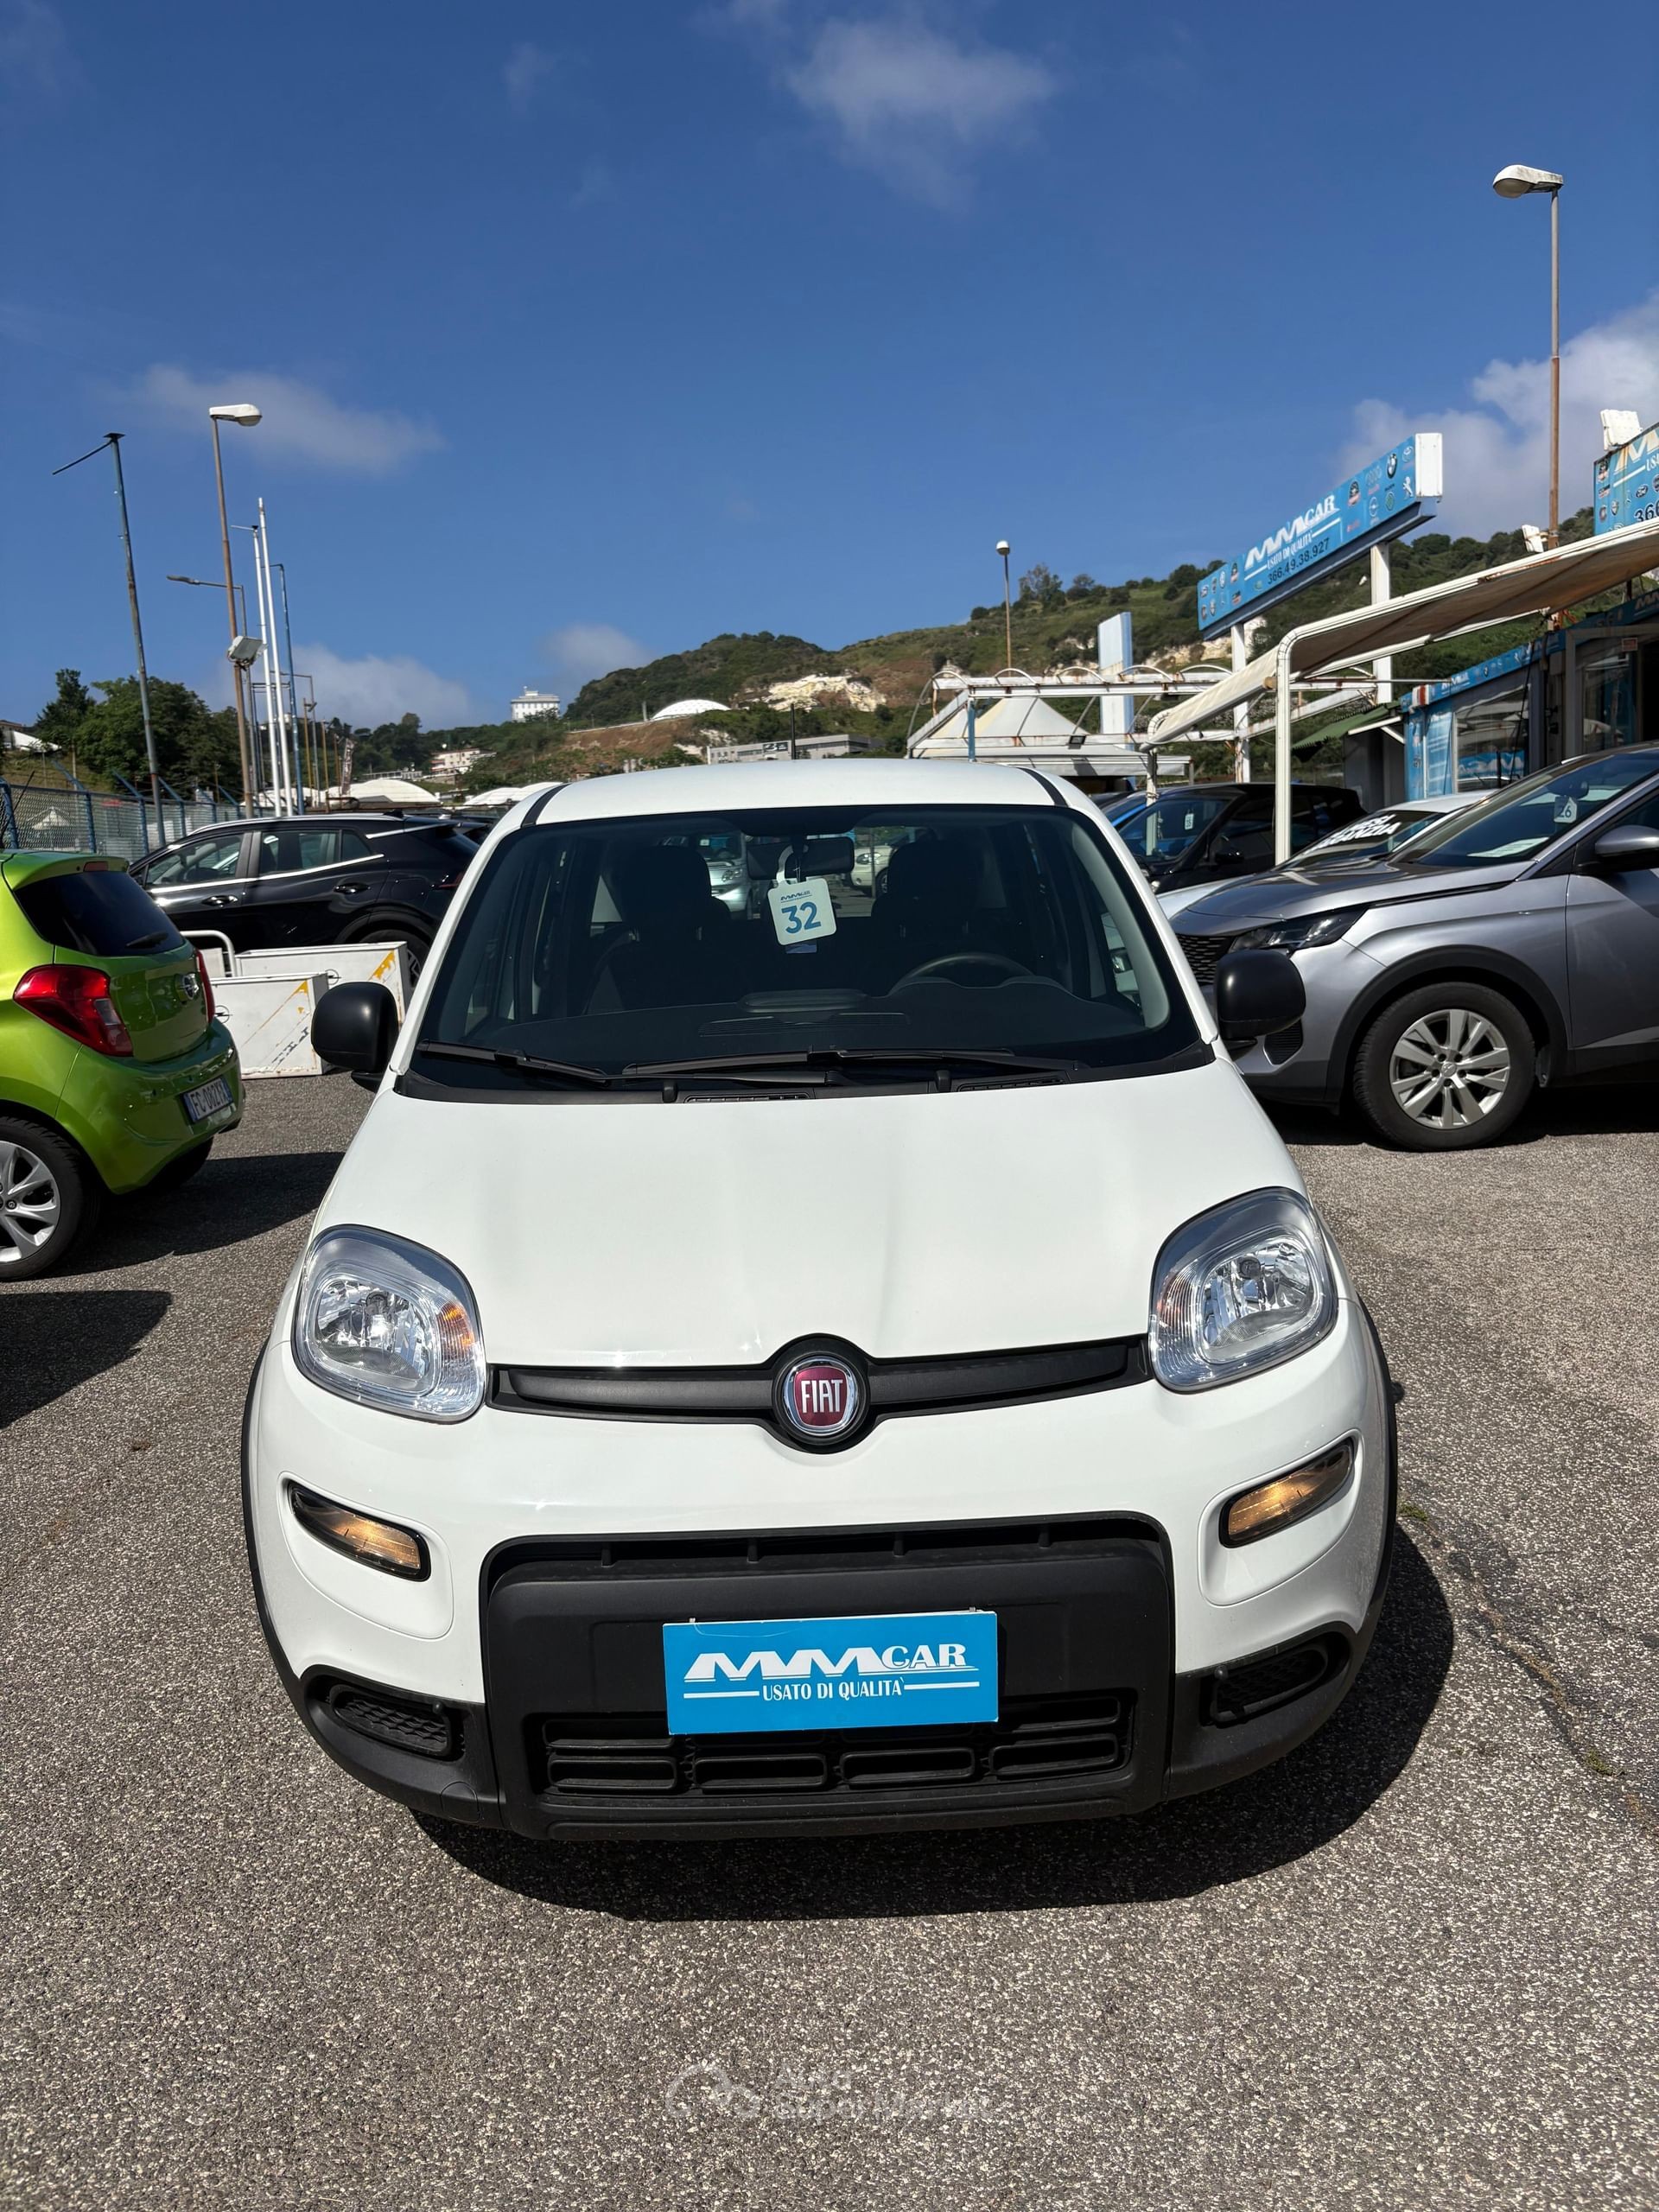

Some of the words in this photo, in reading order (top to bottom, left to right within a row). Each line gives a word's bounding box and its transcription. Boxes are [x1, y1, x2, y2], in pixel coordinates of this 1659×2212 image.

[1267, 537, 1330, 585] 366.49.38.927
[780, 901, 822, 934] 32
[800, 1379, 843, 1414] FIAT
[762, 1682, 812, 1701] USATO
[817, 1682, 833, 1700] DI
